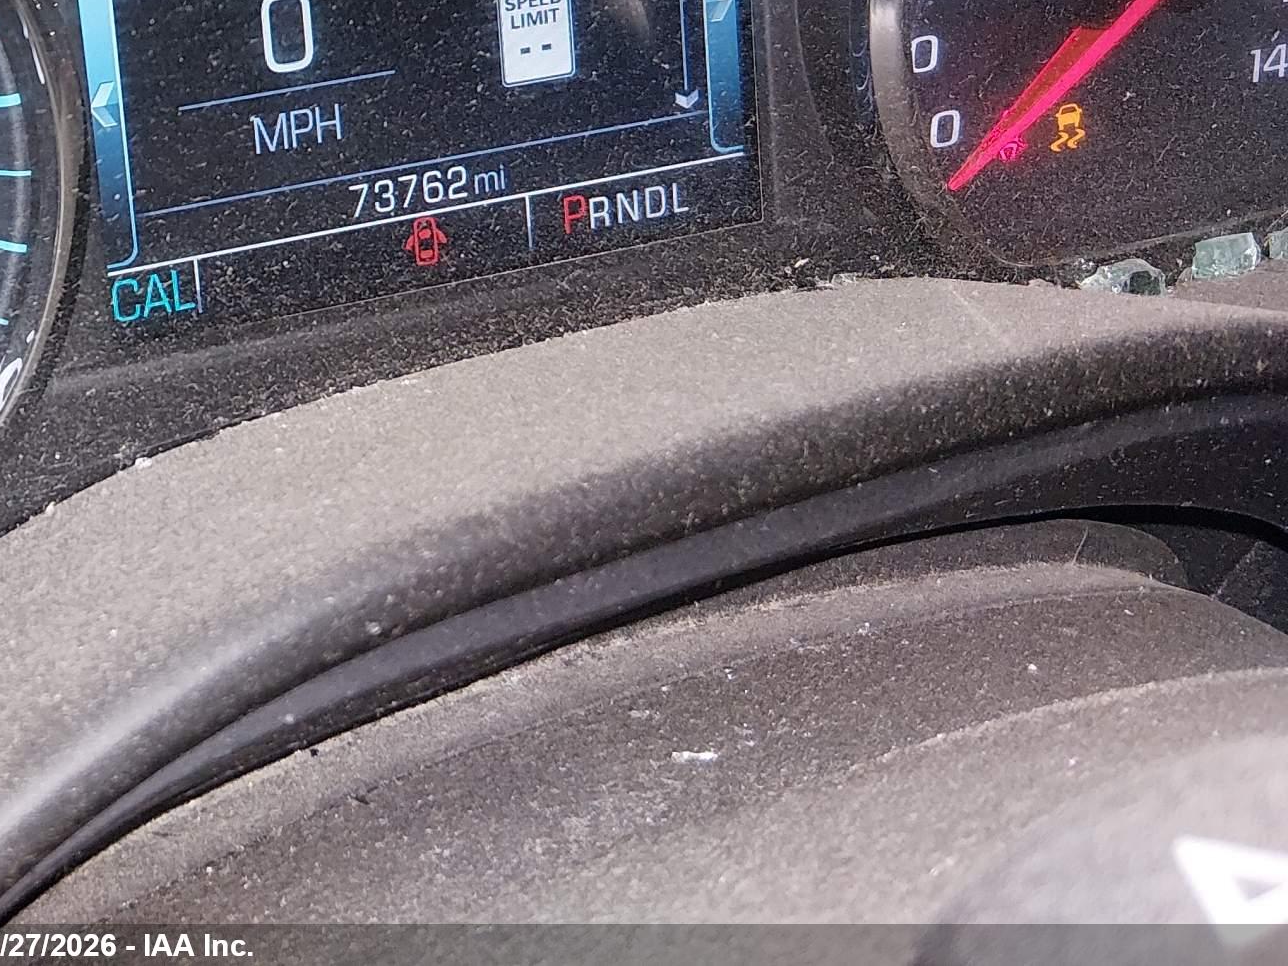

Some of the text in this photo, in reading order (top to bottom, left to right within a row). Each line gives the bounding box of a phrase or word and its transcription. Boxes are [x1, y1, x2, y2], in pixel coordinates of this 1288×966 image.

[510, 8, 560, 30] LIMIT
[1250, 43, 1288, 83] 14
[251, 102, 343, 155] MPH
[930, 109, 960, 148] 0
[348, 164, 507, 219] 73762 mi
[110, 270, 196, 323] CAL
